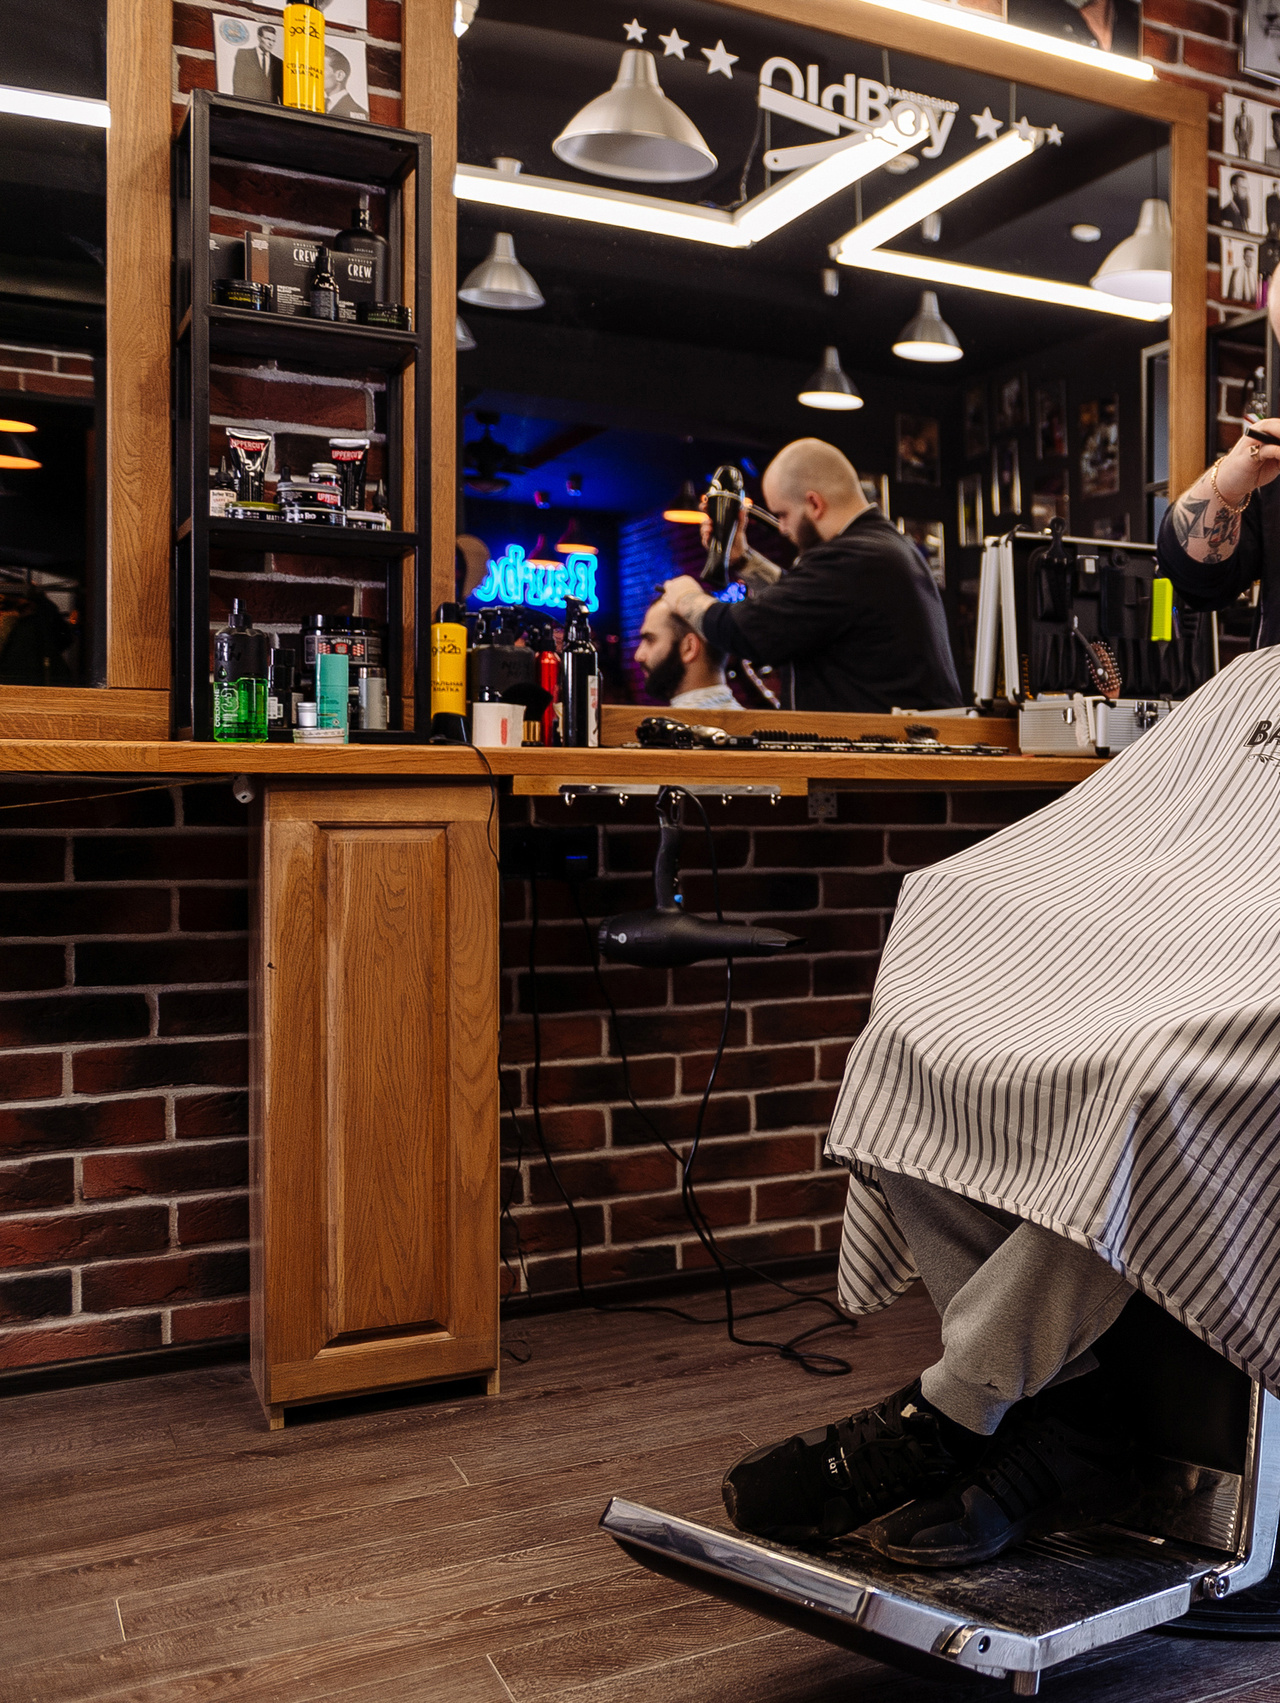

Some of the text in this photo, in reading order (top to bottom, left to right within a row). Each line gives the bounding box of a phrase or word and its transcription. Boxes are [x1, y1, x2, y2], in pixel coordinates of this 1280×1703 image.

[759, 56, 956, 159] OldBoy
[347, 263, 373, 279] CREW
[828, 1457, 838, 1474] EQT
